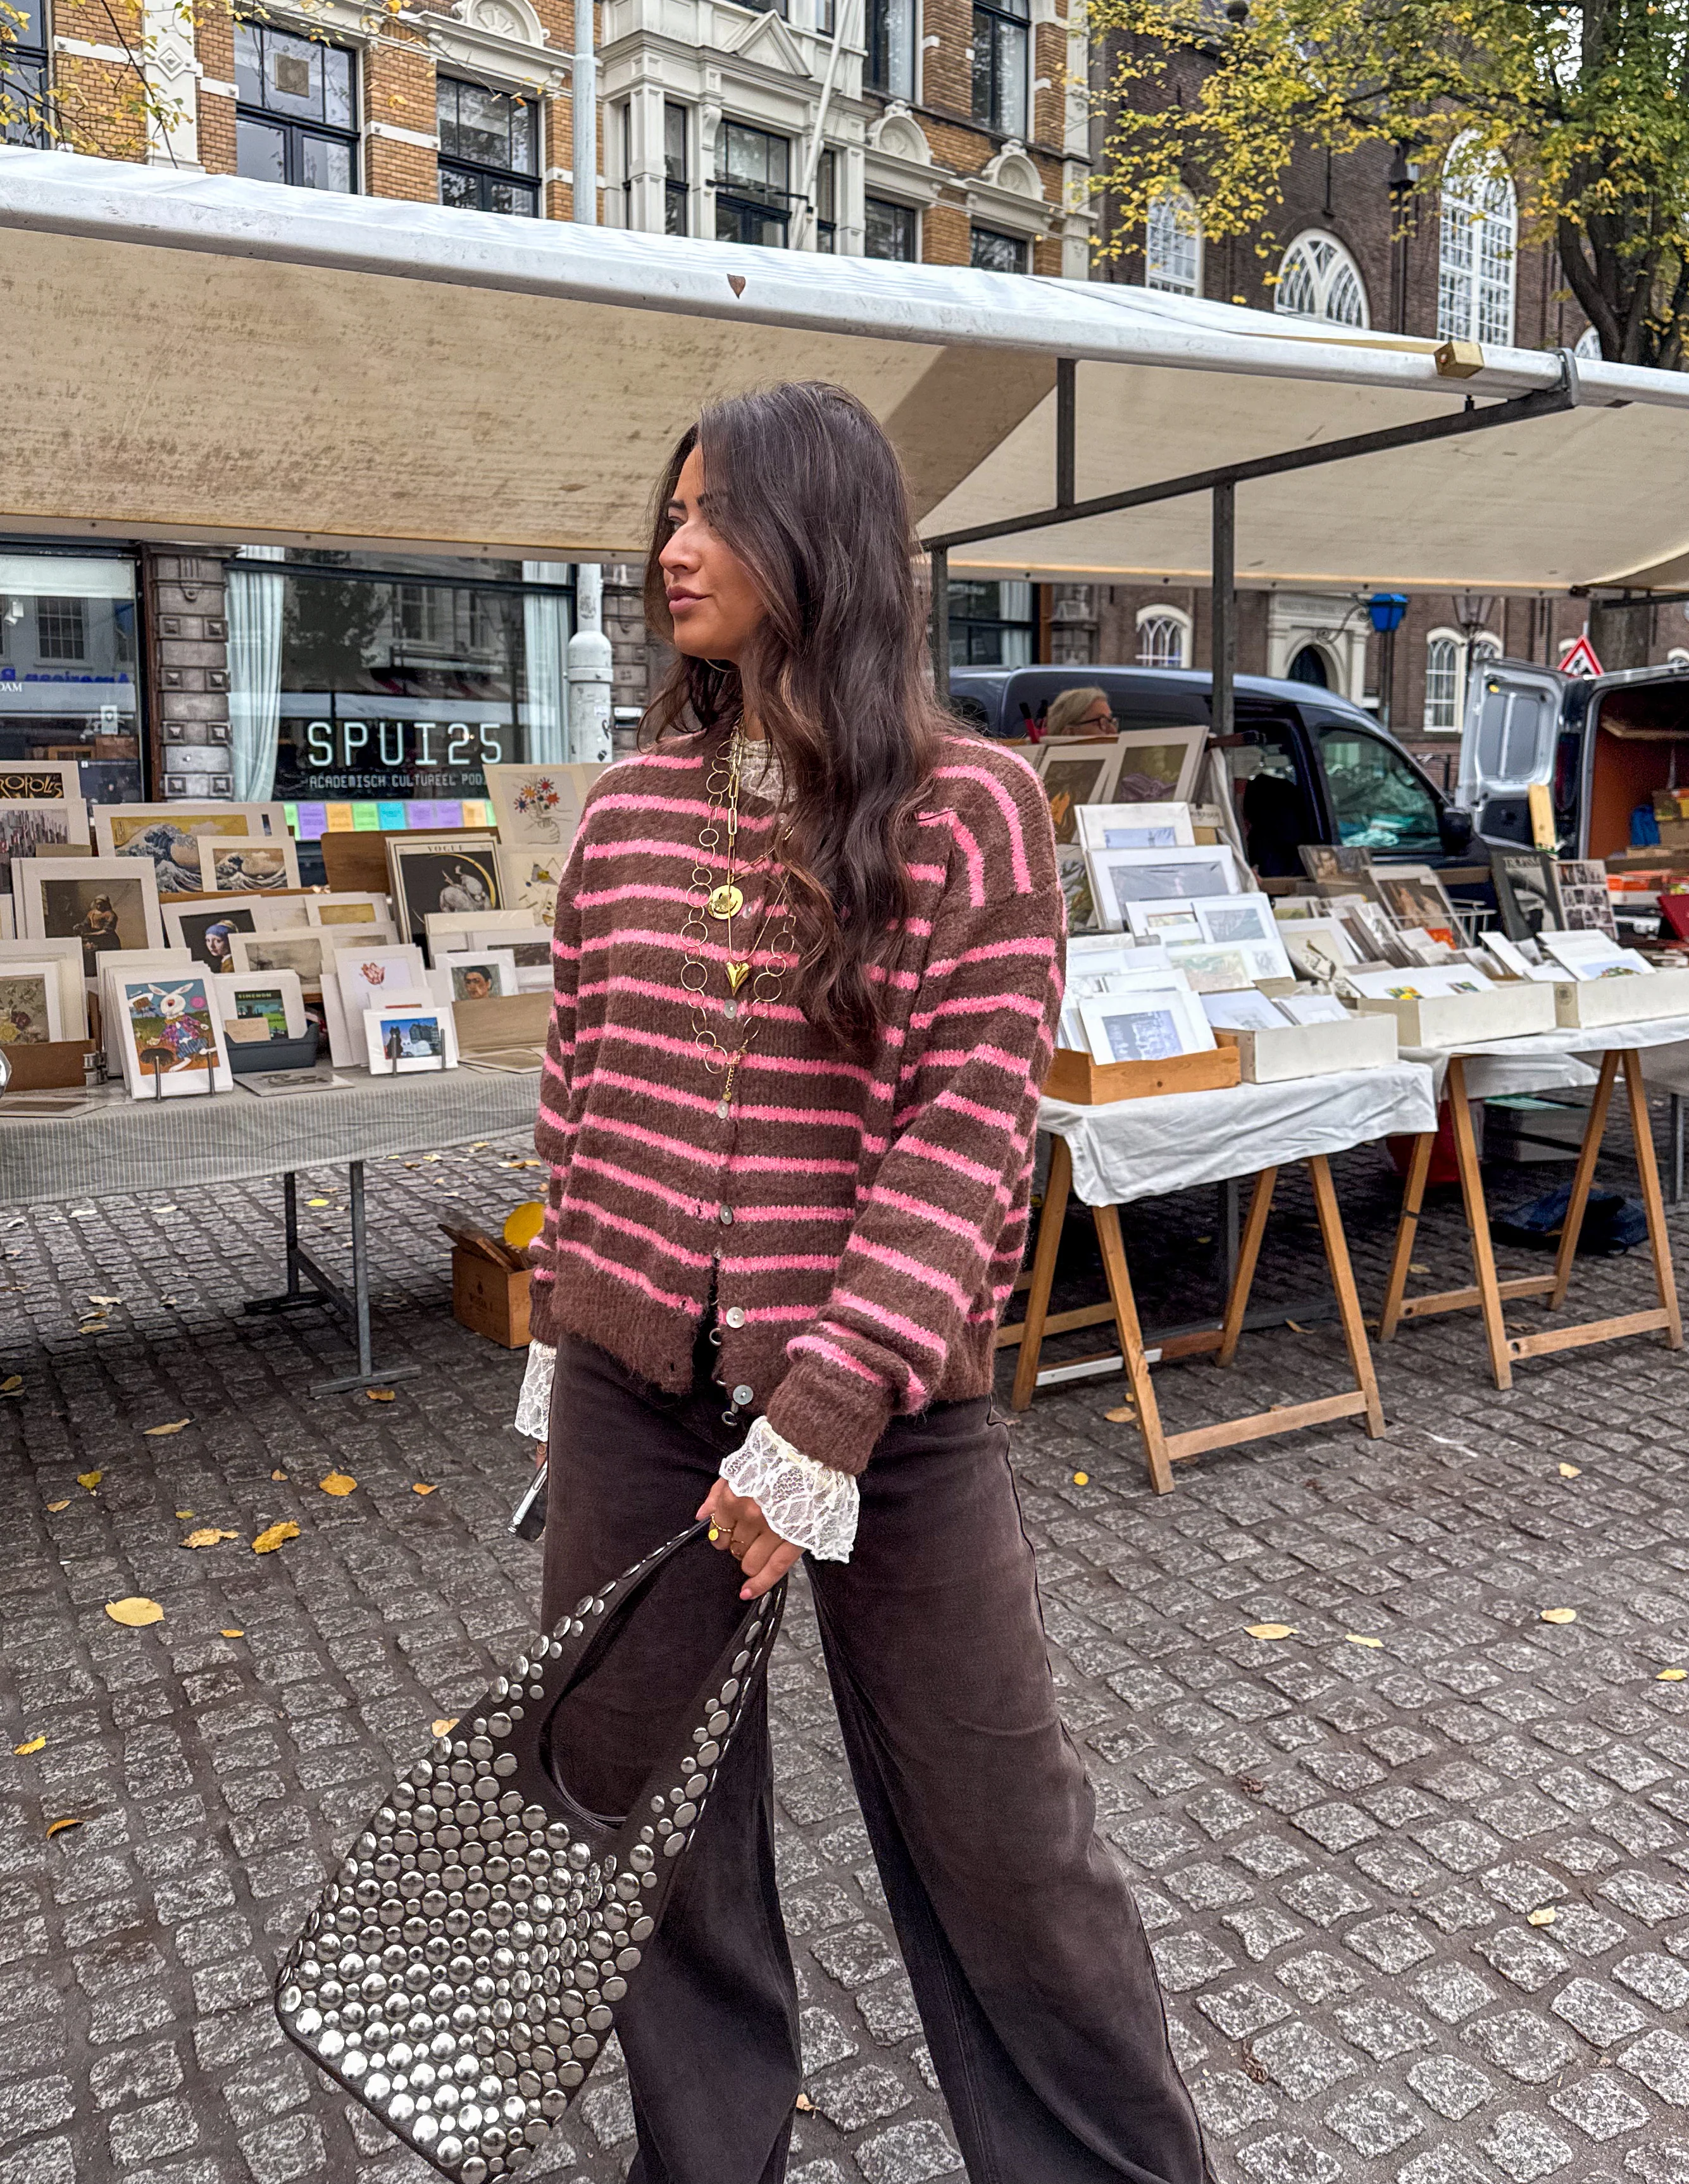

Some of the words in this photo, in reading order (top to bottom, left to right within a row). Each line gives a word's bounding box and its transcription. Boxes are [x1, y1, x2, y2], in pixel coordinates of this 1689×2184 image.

[308, 722, 502, 766] SPUI25
[309, 774, 386, 788] ACADEMISCH
[391, 773, 456, 788] CULTUREEL
[461, 772, 487, 786] POD
[427, 844, 464, 852] VOGUE
